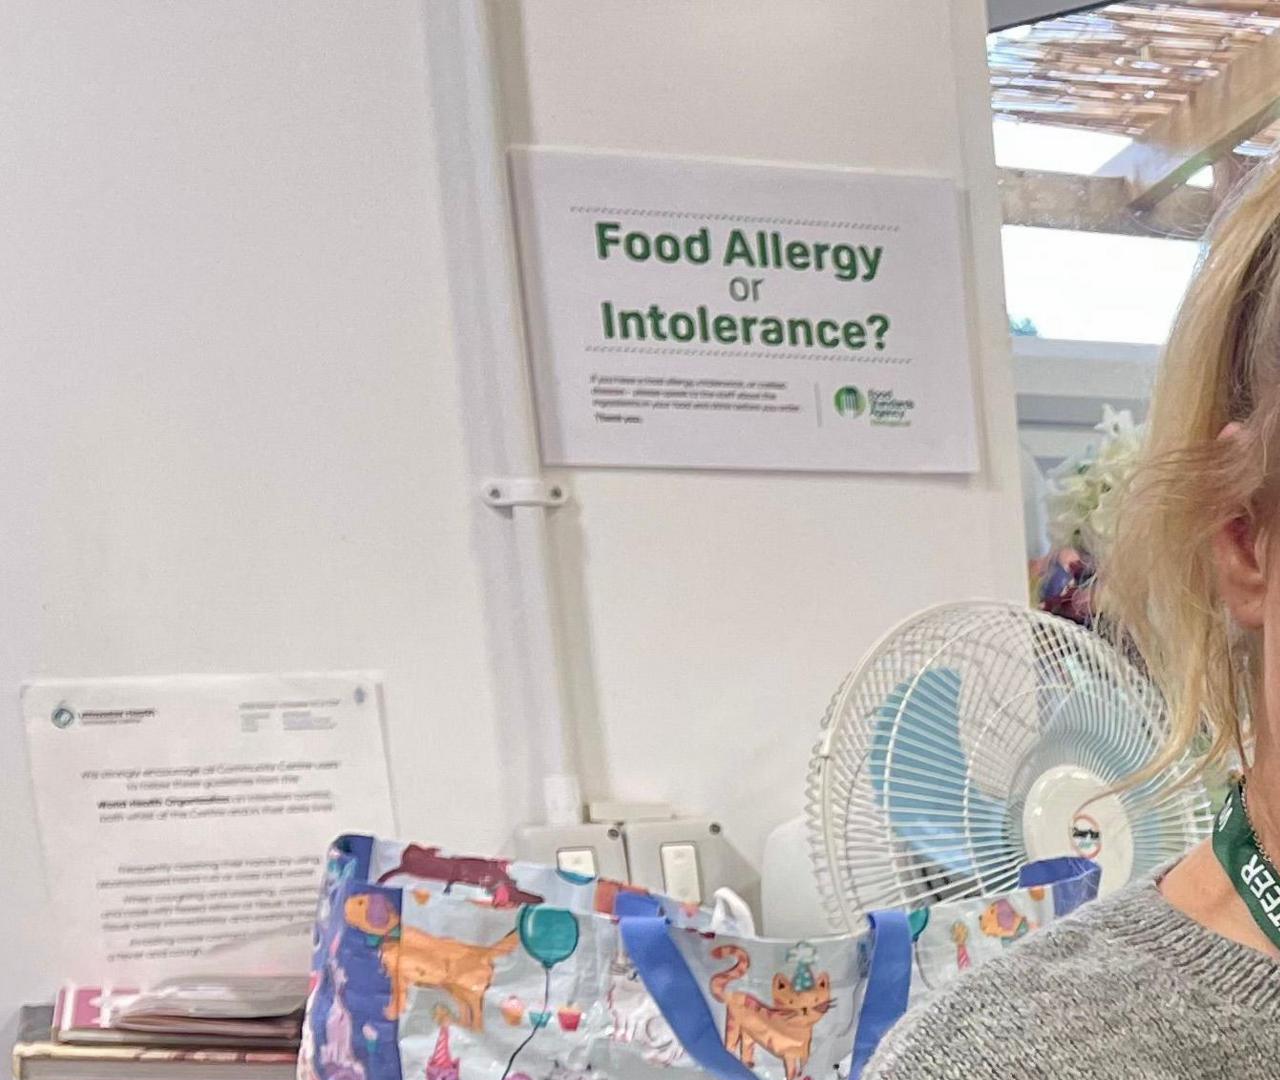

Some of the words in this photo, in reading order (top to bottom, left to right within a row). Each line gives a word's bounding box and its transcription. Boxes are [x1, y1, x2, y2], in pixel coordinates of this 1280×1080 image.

[595, 221, 711, 264] Food
[722, 228, 883, 282] Allergy
[728, 275, 764, 302] or
[600, 300, 891, 351] Intolerance?
